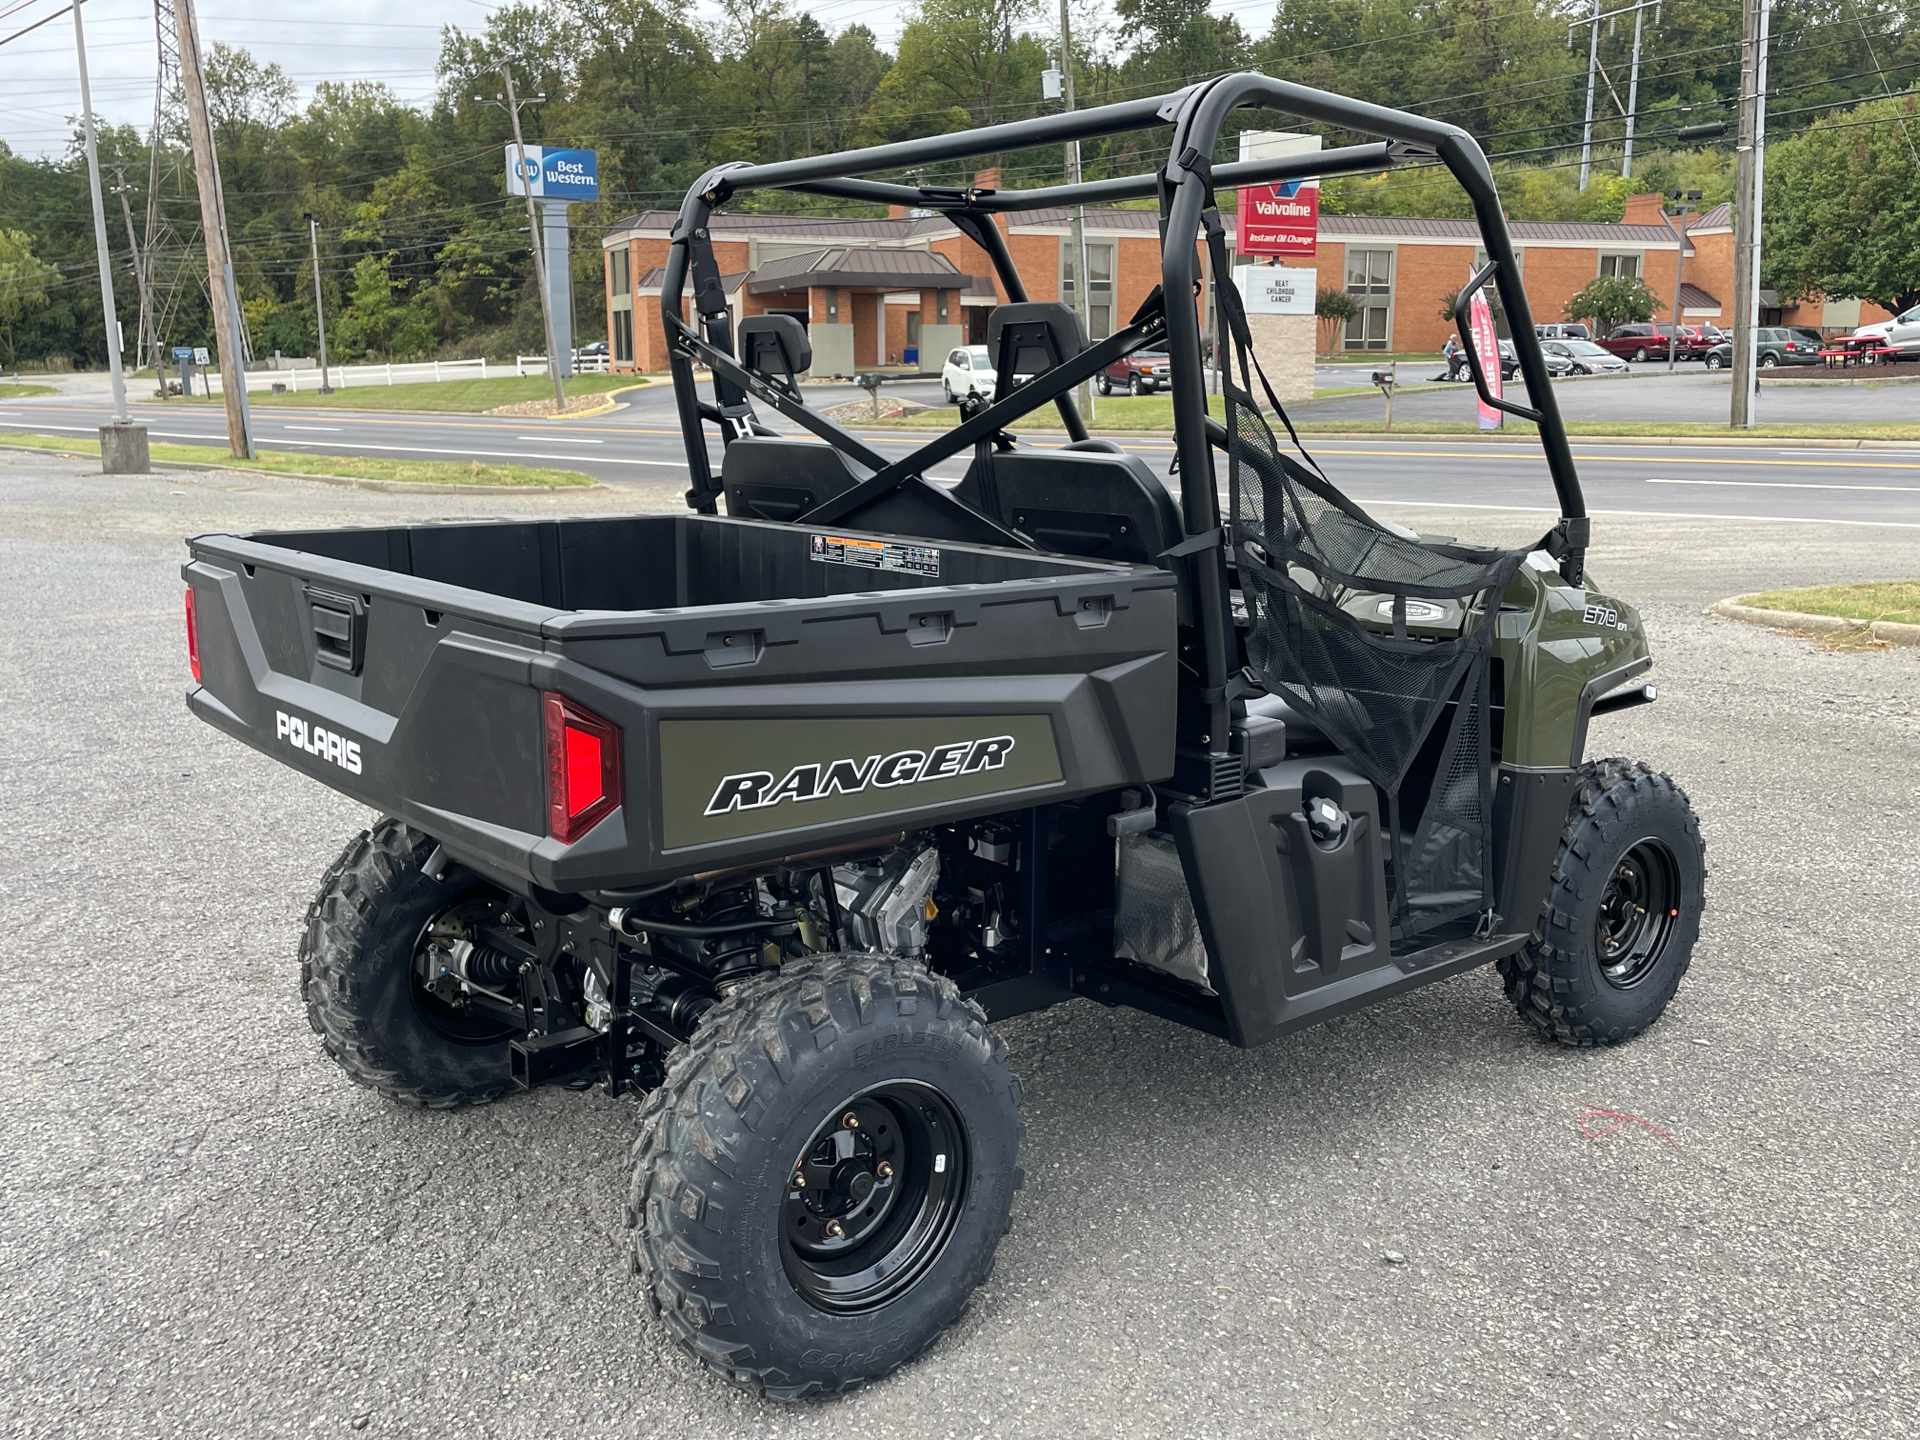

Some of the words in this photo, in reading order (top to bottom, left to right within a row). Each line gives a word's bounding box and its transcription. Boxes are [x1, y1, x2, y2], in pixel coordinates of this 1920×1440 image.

[557, 160, 584, 174] Best
[546, 170, 596, 186] Western
[1255, 201, 1311, 217] Valvoline
[1249, 233, 1277, 243] Instant
[1276, 234, 1287, 243] Oil
[1287, 234, 1314, 246] Change
[1266, 287, 1295, 295] CHILDHOOD
[1274, 279, 1289, 288] BEAT
[1270, 295, 1292, 303] CANCER
[1583, 604, 1618, 628] 570
[276, 709, 362, 776] POLARIS
[703, 735, 1015, 816] RANGER
